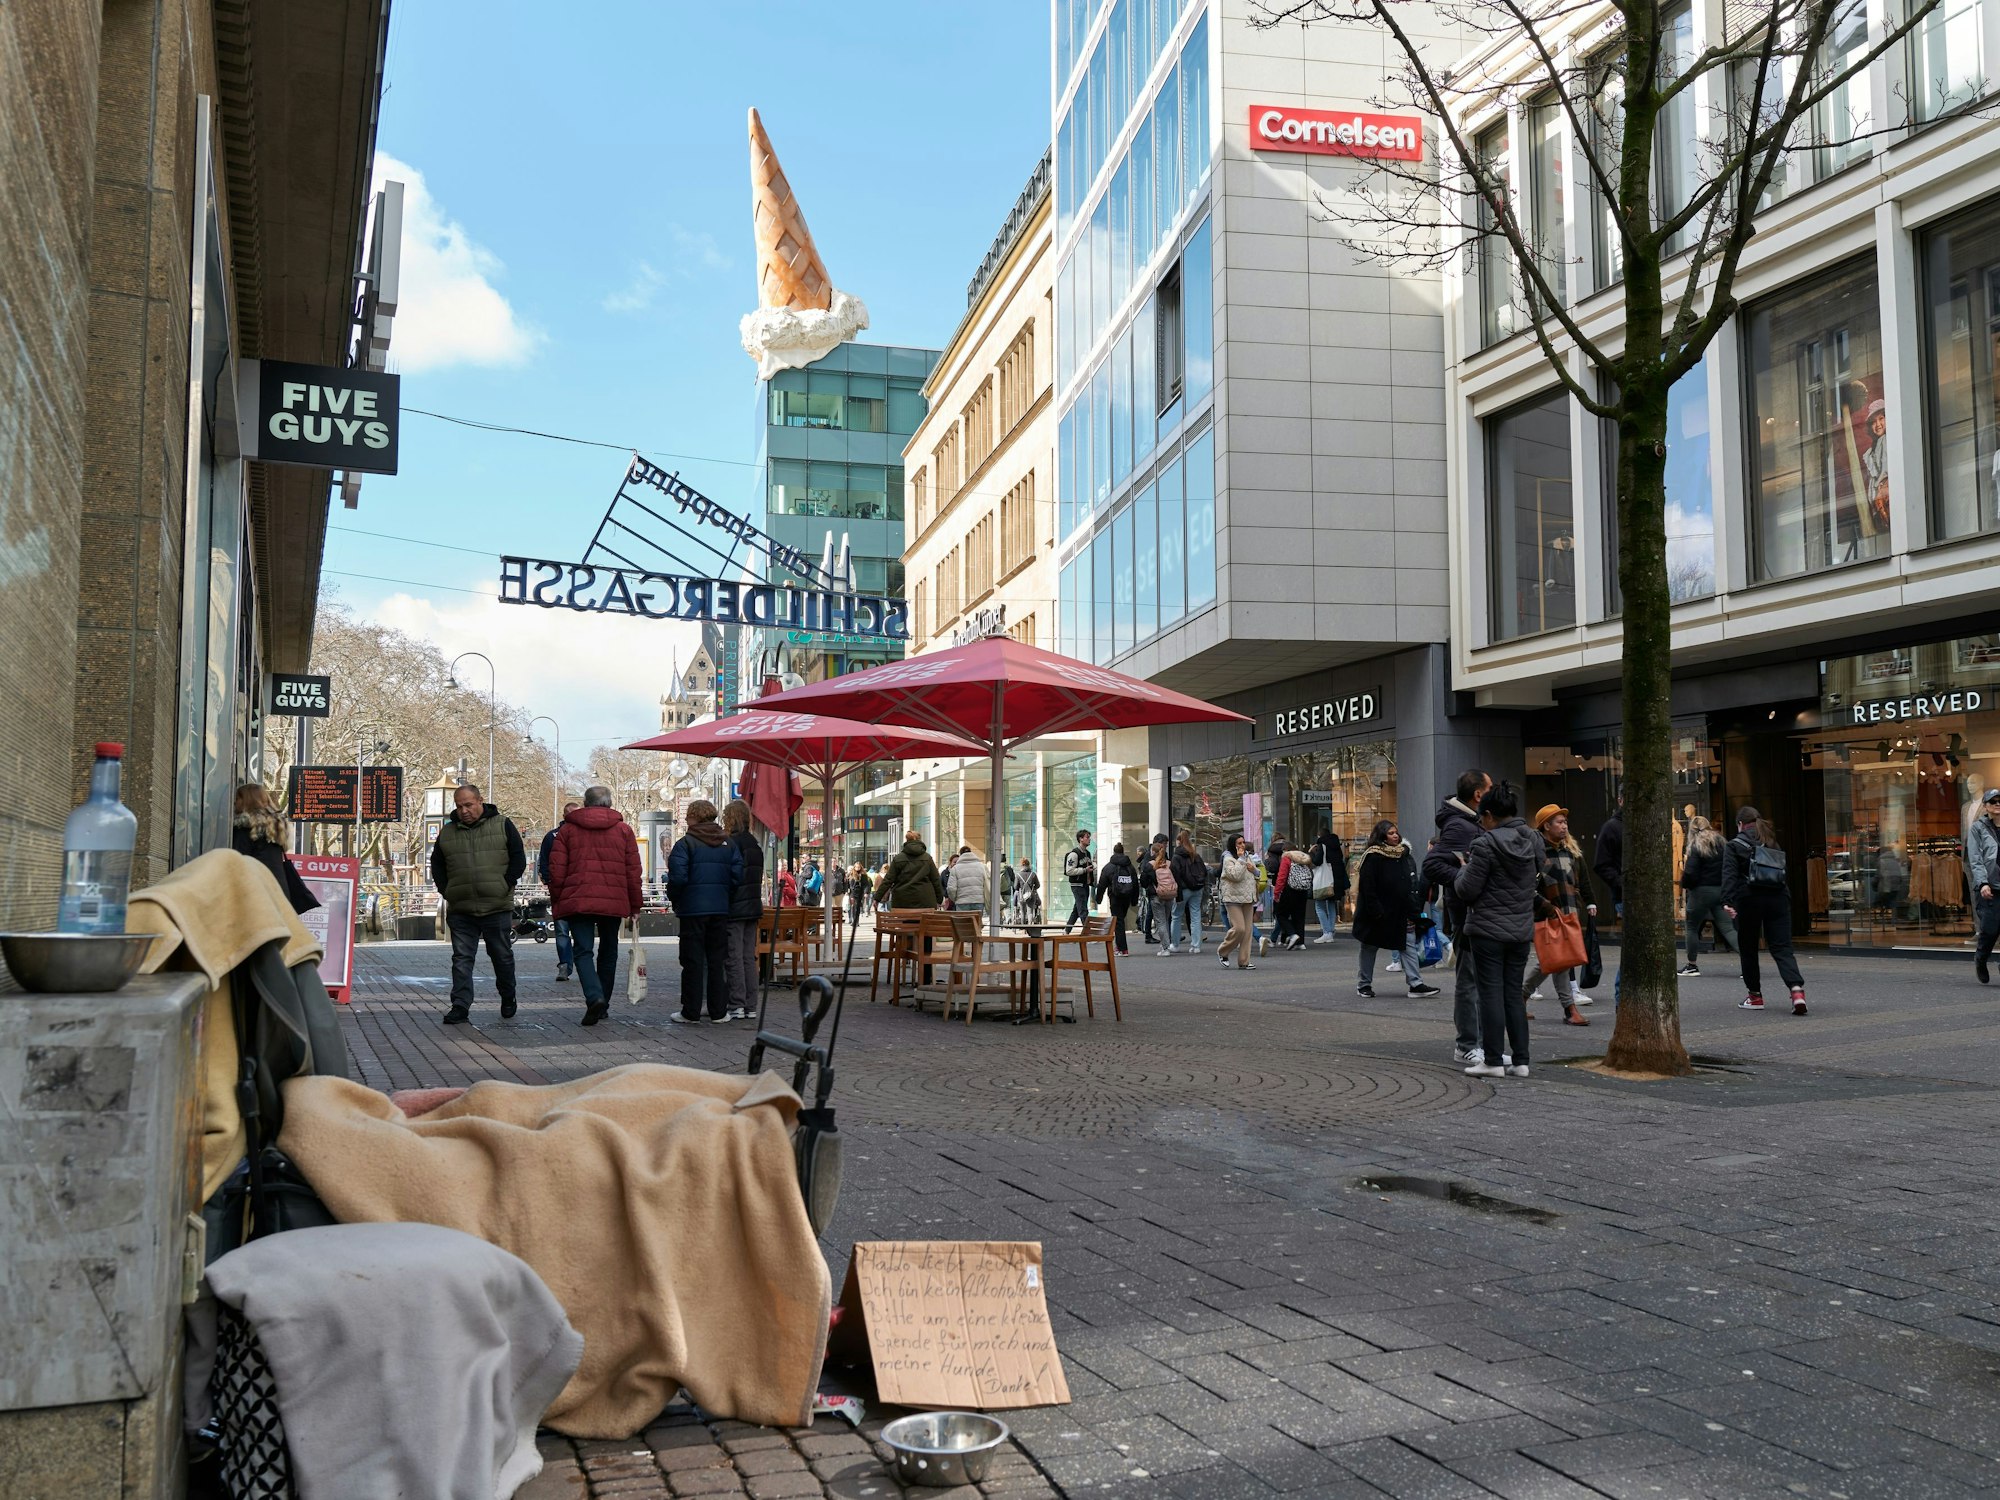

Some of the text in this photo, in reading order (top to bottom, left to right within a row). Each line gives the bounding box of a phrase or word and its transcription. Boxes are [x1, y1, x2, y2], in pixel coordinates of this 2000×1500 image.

[1259, 110, 1415, 149] Cornelsen
[282, 381, 378, 418] FIVE
[268, 411, 390, 449] GUYS
[834, 667, 948, 689] GUYS
[870, 658, 965, 677] FIVE
[281, 681, 322, 696] FIVE
[275, 694, 326, 709] GUYS
[1853, 691, 1981, 723] RESERVED
[737, 713, 818, 727] FIVE
[1276, 694, 1374, 736] RESERVED
[715, 722, 816, 737] GUYS
[307, 861, 349, 873] GUYS
[861, 1243, 910, 1273] Hallo
[861, 1276, 892, 1298] Ich
[899, 1276, 918, 1298] bin
[923, 1274, 960, 1298] kein
[865, 1300, 914, 1325] Bitte
[923, 1315, 949, 1326] um
[957, 1309, 998, 1326] eine
[874, 1328, 933, 1353] Spende
[974, 1329, 1020, 1351] mich
[1022, 1335, 1052, 1351] und
[879, 1353, 932, 1370] meine
